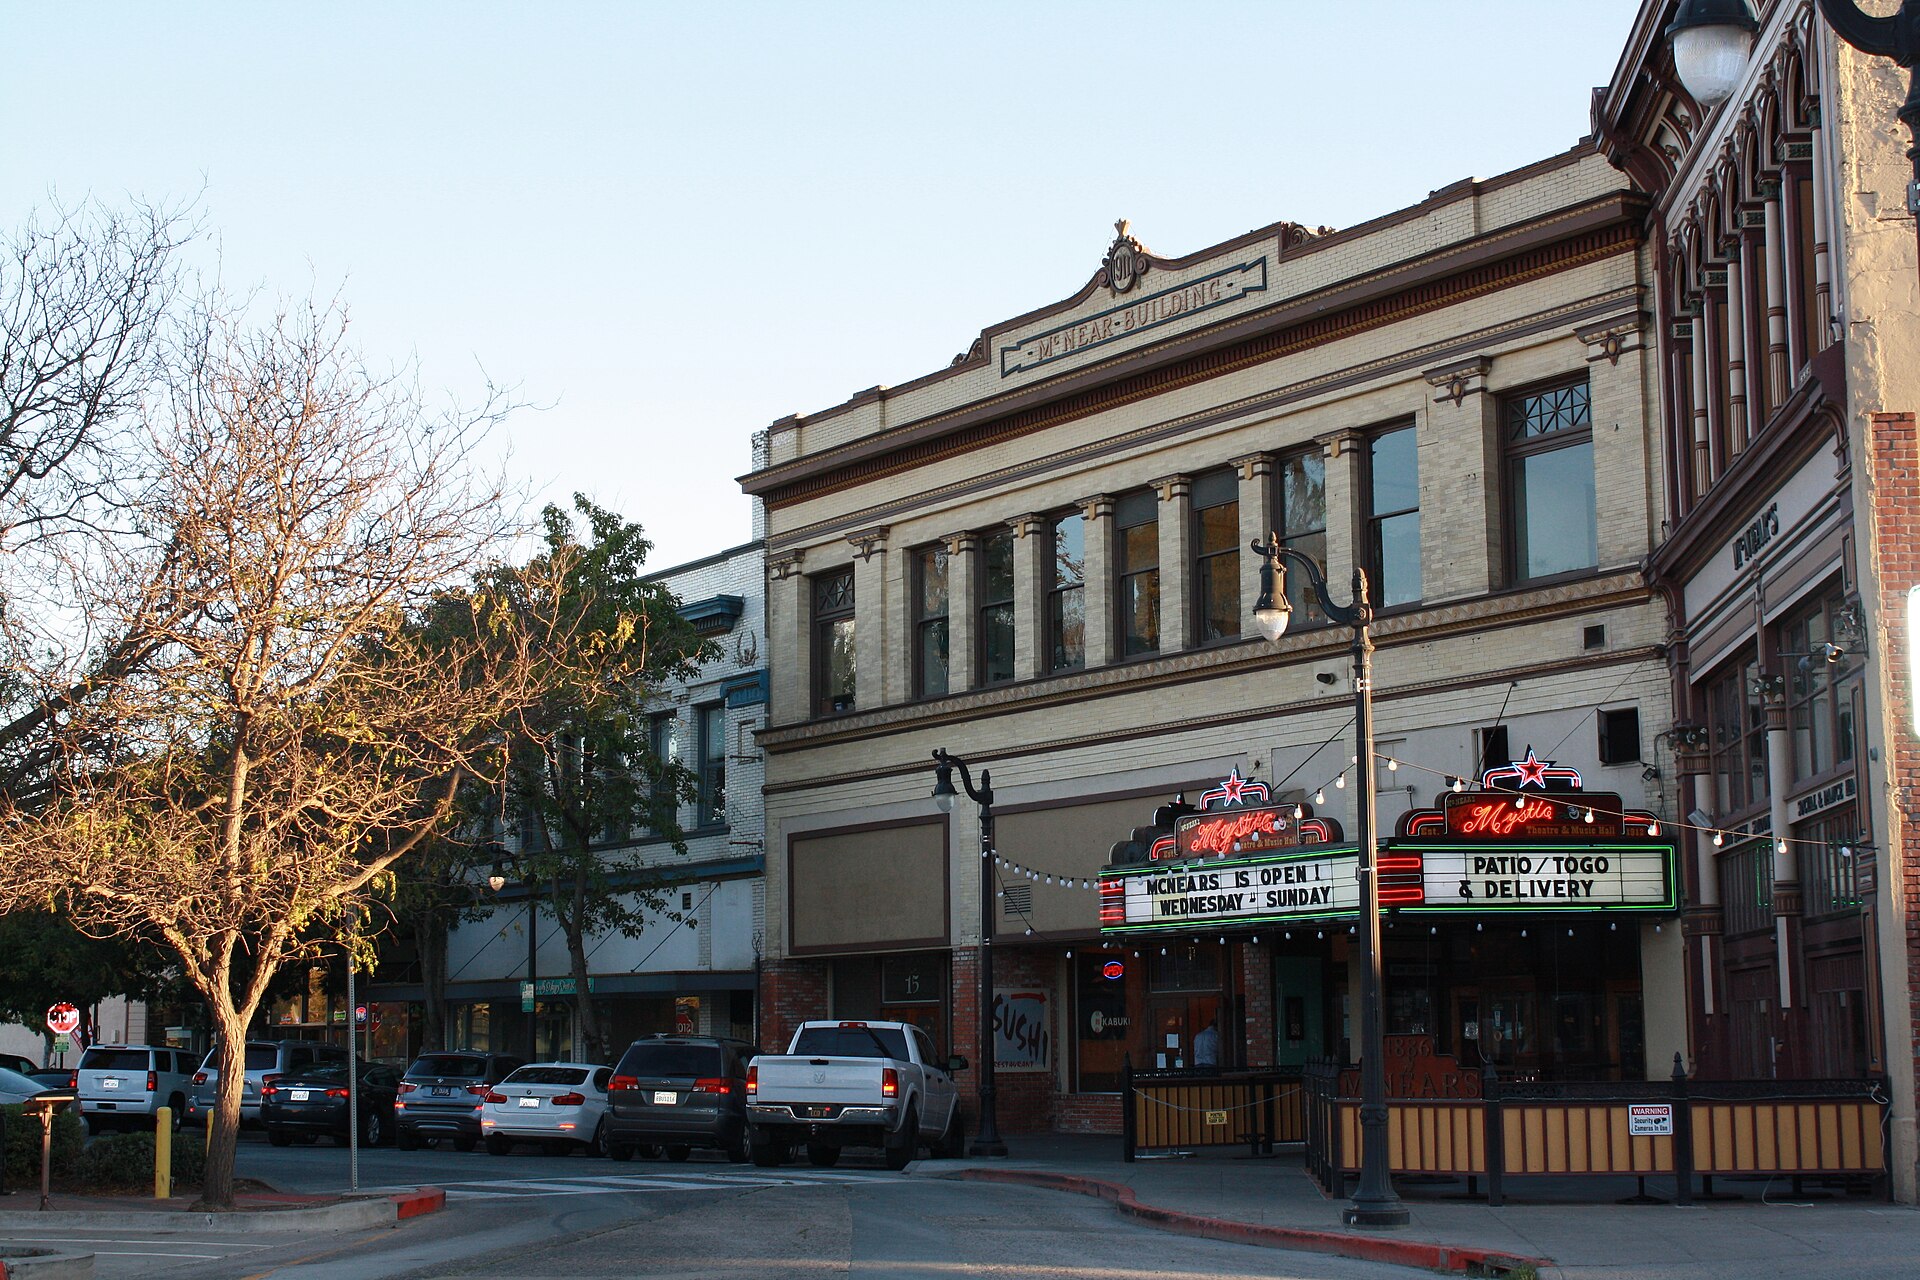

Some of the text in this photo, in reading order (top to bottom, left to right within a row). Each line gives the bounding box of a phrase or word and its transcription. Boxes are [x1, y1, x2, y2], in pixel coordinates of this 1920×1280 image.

[1113, 255, 1131, 281] 1911
[1123, 279, 1221, 332] BUILDING
[1463, 801, 1554, 835] Mystic
[1526, 826, 1615, 836] Theatre & Music Hall
[1191, 812, 1277, 854] Mystic
[1147, 873, 1219, 896] MCNEARS
[1235, 870, 1250, 887] IS
[1458, 880, 1594, 898] & DELIVERY
[1160, 893, 1244, 916] WEDNESDAY
[1266, 886, 1331, 908] SUNDAY
[992, 993, 1048, 1068] SUSHI
[1103, 1016, 1131, 1026] KABUKI
[1633, 1107, 1668, 1115] WARNING
[1634, 1117, 1654, 1125] Security
